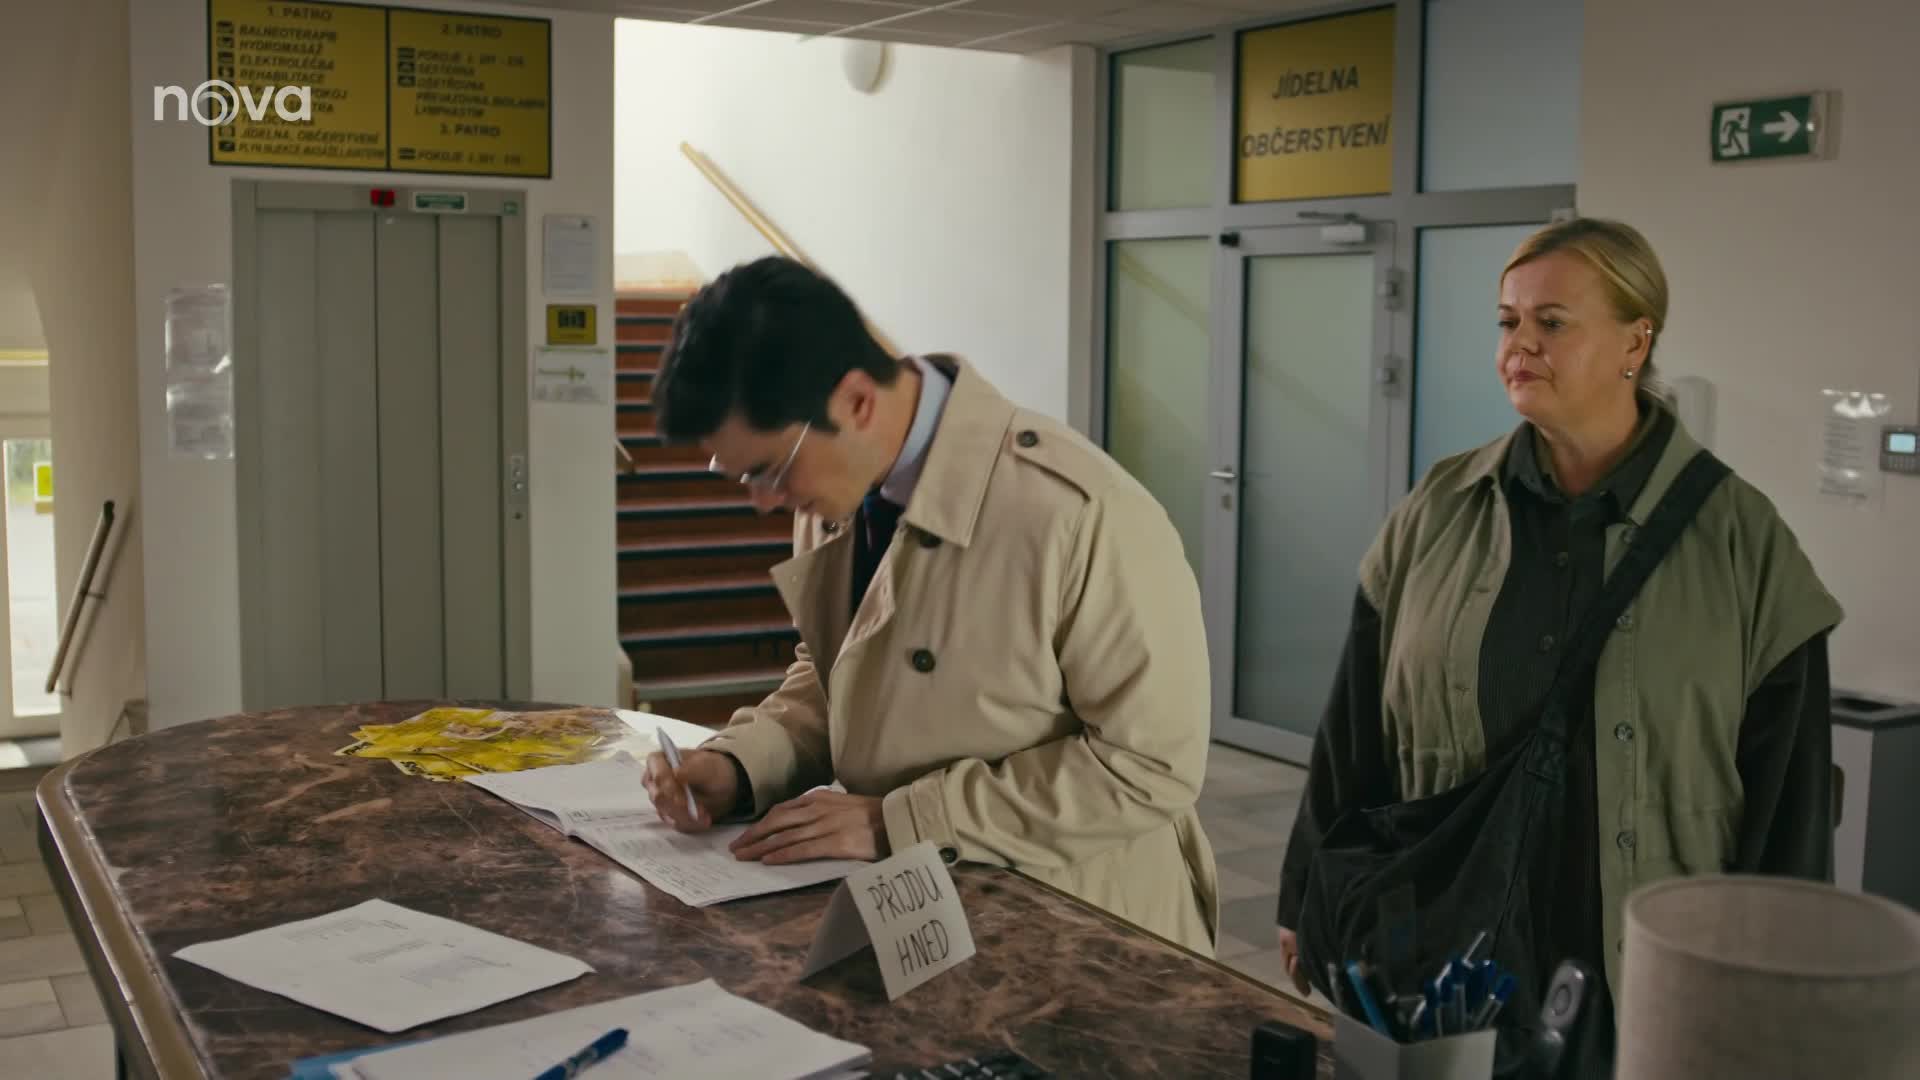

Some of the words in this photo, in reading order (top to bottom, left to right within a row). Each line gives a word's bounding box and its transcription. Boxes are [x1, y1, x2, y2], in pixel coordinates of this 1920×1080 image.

[282, 7, 334, 21] PATRO
[456, 24, 503, 39] PATRO
[1271, 64, 1360, 100] JÍDELNA
[454, 123, 502, 139] PATRO
[1241, 113, 1392, 159] OBČERSTVENÍ
[895, 919, 949, 976] HNED
